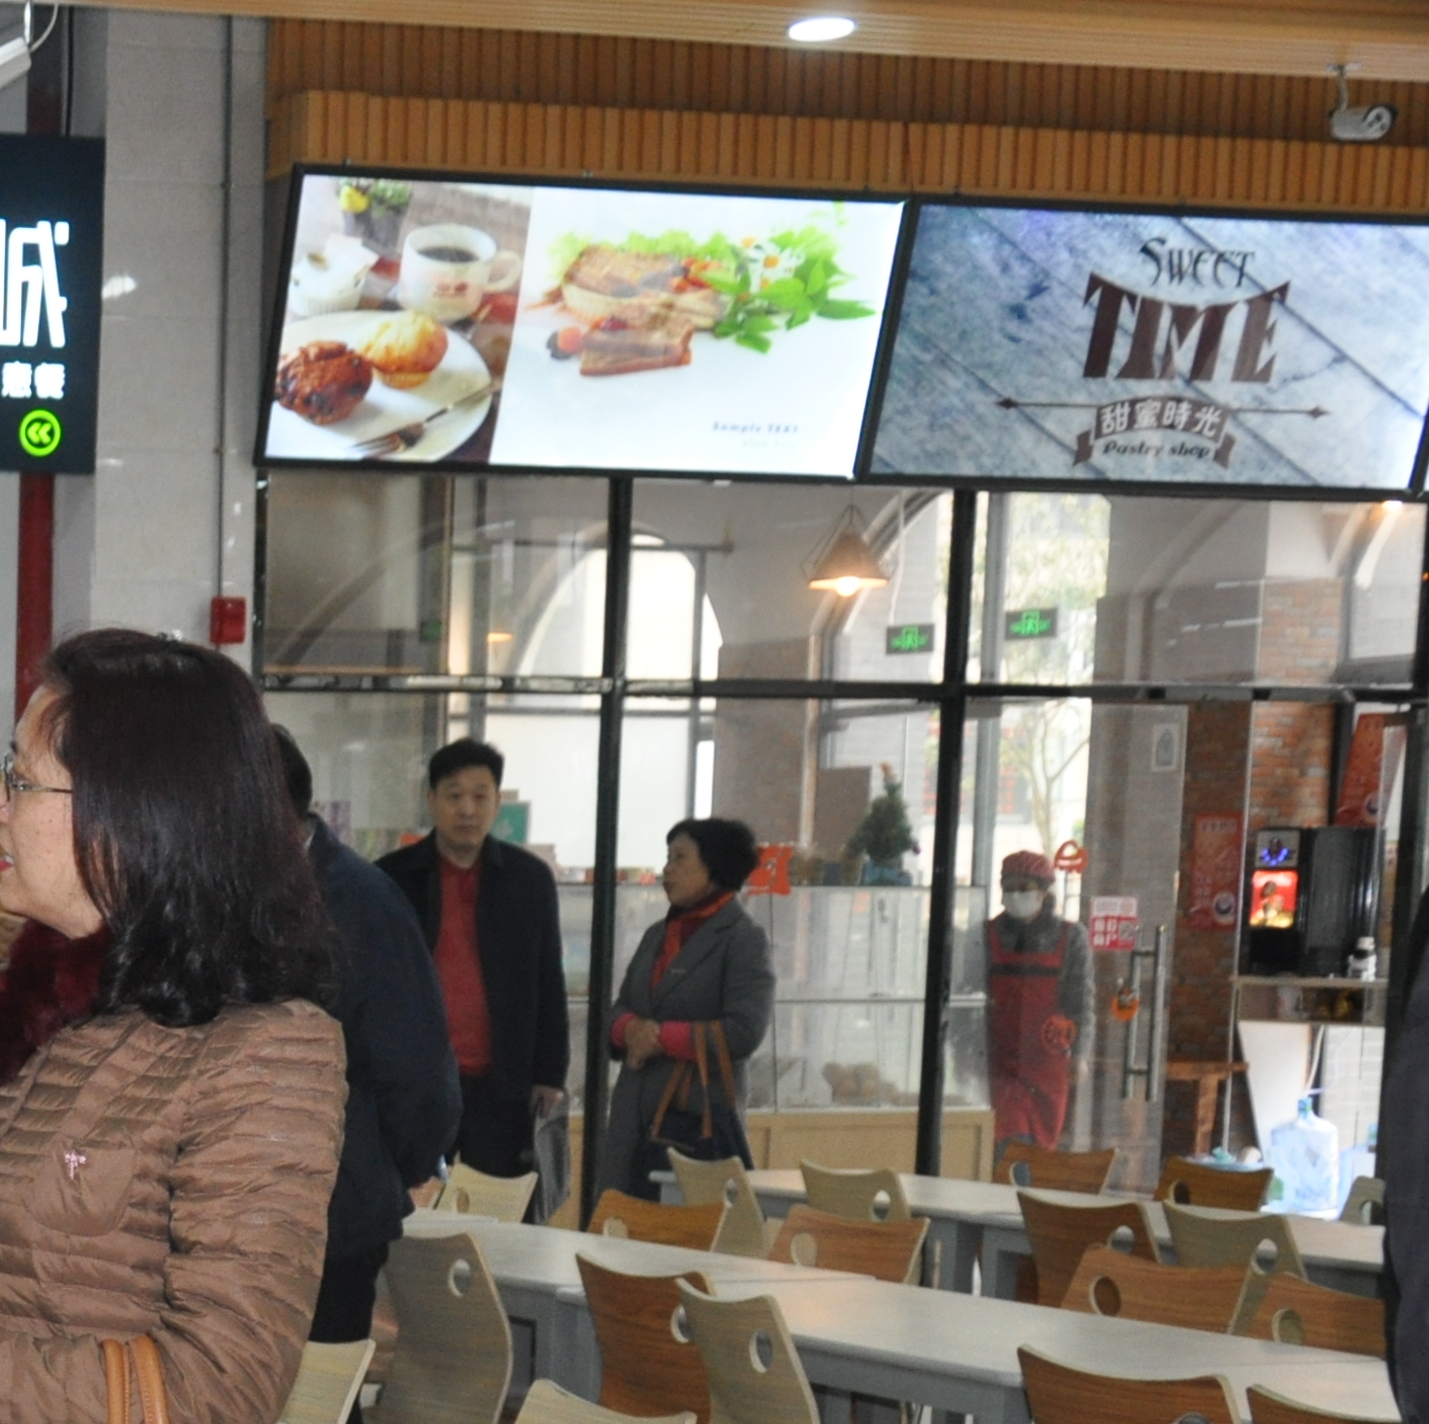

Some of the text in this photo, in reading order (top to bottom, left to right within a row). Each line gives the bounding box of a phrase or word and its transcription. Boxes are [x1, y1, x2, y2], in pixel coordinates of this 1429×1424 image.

[1082, 272, 1291, 384] TIME
[1100, 400, 1223, 438] 甜蜜時光
